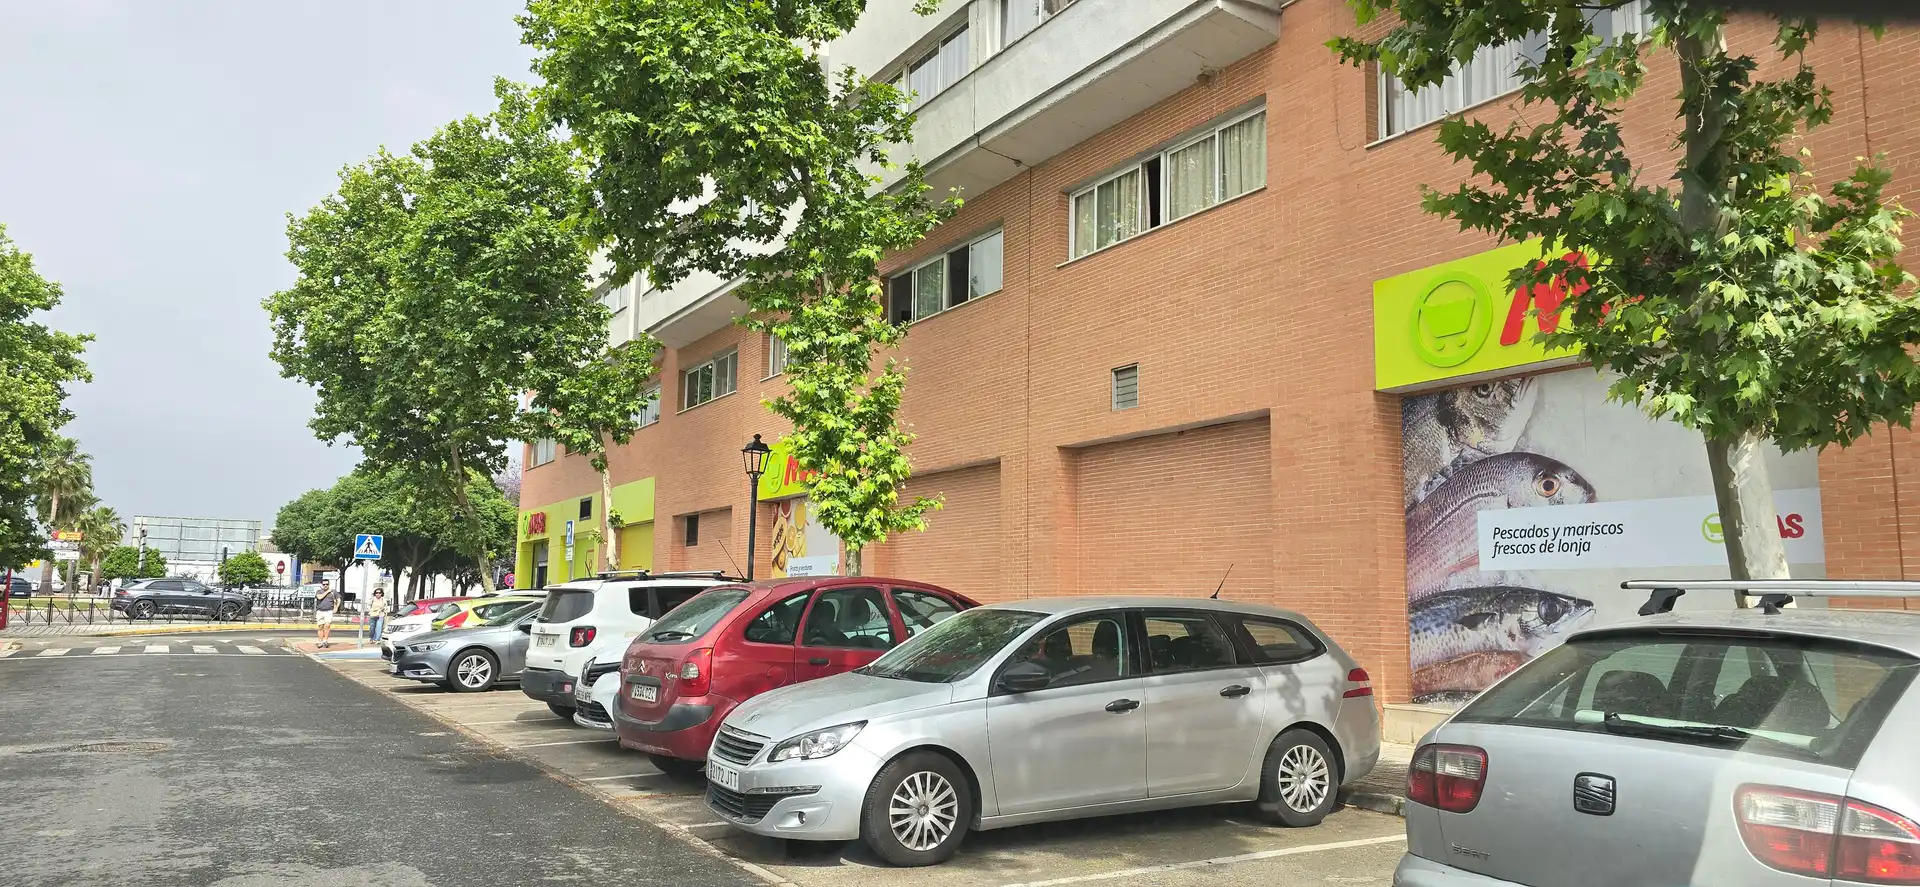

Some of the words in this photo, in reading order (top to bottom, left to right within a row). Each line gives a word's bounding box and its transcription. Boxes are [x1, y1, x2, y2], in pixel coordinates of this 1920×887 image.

[1493, 525, 1549, 539] Pescados
[1552, 526, 1560, 541] y
[1563, 522, 1624, 537] mariscos
[1492, 541, 1536, 559] frescos
[1539, 540, 1555, 553] de
[1558, 538, 1591, 556] lonja
[725, 770, 737, 788] JTT
